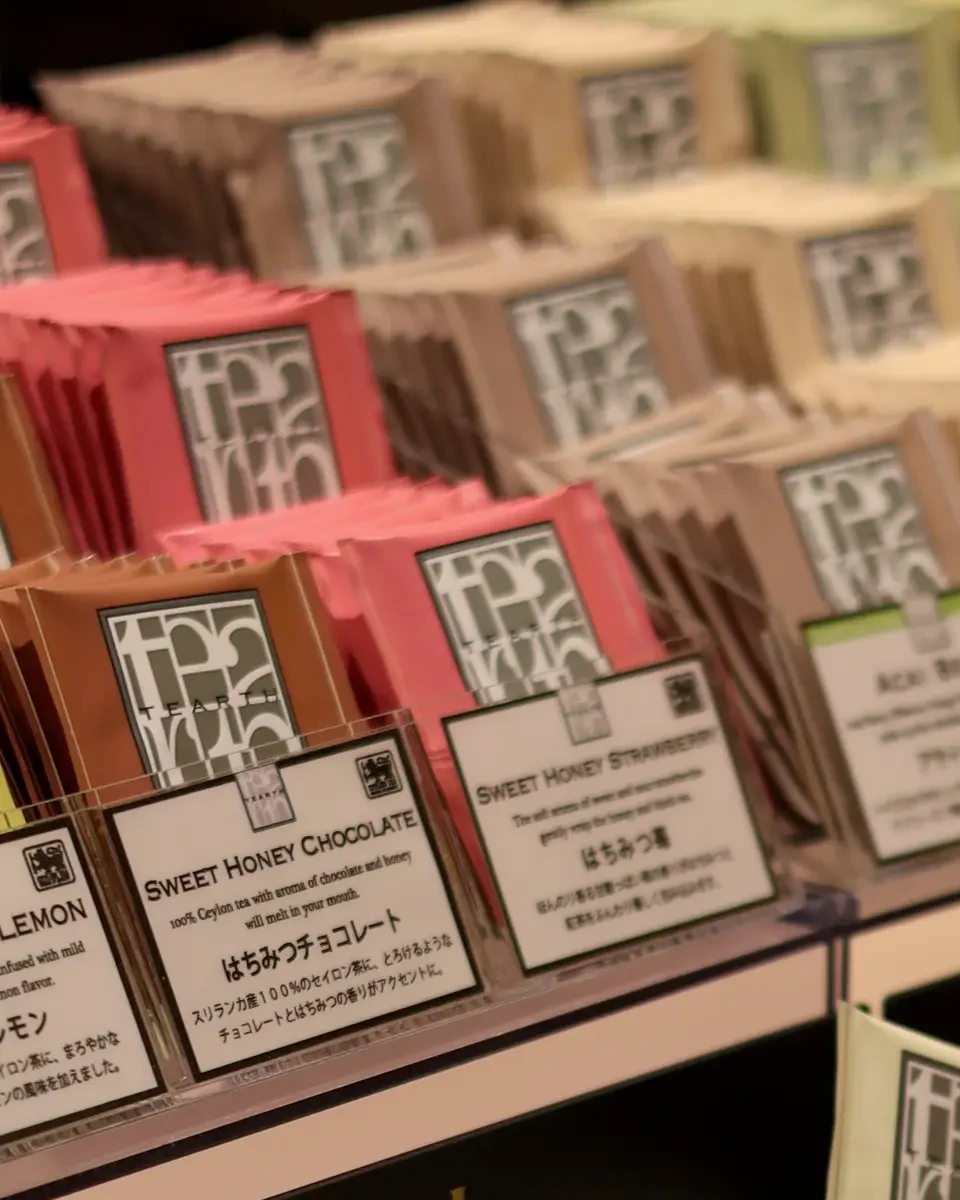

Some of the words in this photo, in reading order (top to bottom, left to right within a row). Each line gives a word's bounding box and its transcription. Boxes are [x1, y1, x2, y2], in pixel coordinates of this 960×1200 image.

[139, 688, 279, 721] TEARTH
[475, 774, 537, 806] SWEET
[542, 758, 603, 786] HONEY
[144, 864, 218, 902] SWEET
[223, 843, 295, 879] HONEY
[300, 809, 417, 857] CHOCOLATE
[169, 911, 198, 930] 100%
[196, 902, 235, 922] Ceylon
[233, 897, 252, 911] tea
[250, 888, 275, 905] with
[274, 881, 308, 899] aroma
[307, 874, 319, 889] of
[319, 864, 365, 886] chocolate
[364, 856, 384, 873] and
[381, 851, 412, 867] honey
[244, 913, 265, 930] will
[264, 907, 290, 925] melt
[288, 905, 302, 918] in
[300, 899, 325, 919] your
[325, 887, 360, 907] mouth.
[0, 954, 36, 976] nfused
[35, 948, 61, 965] with
[60, 939, 86, 959] mild
[221, 909, 399, 982] はちみつチョコレート
[20, 976, 56, 994] flavor.
